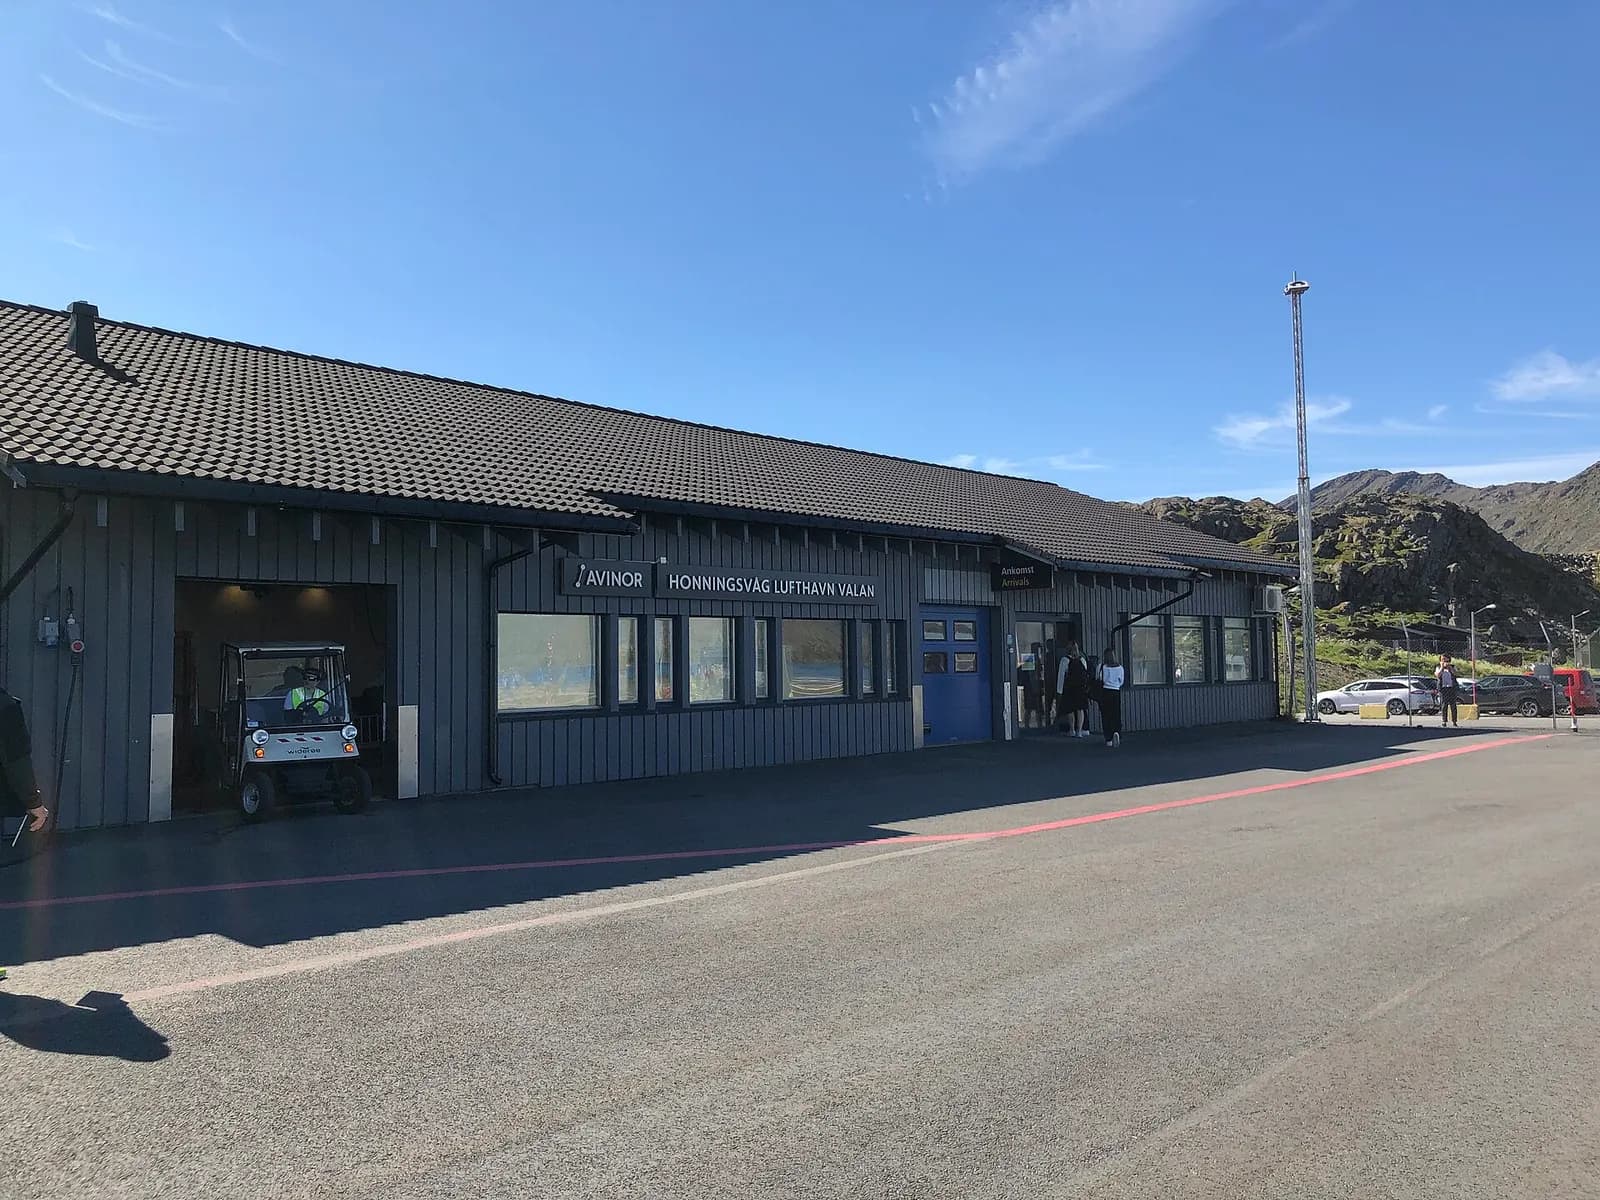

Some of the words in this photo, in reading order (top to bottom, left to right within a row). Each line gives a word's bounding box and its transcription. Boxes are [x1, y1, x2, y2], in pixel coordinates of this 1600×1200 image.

[1001, 566, 1034, 575] Ankomst
[586, 570, 643, 588] AVINOR
[1002, 577, 1030, 587] Arrivals
[774, 579, 835, 596] LUFTHAVN
[838, 583, 875, 597] VALAN
